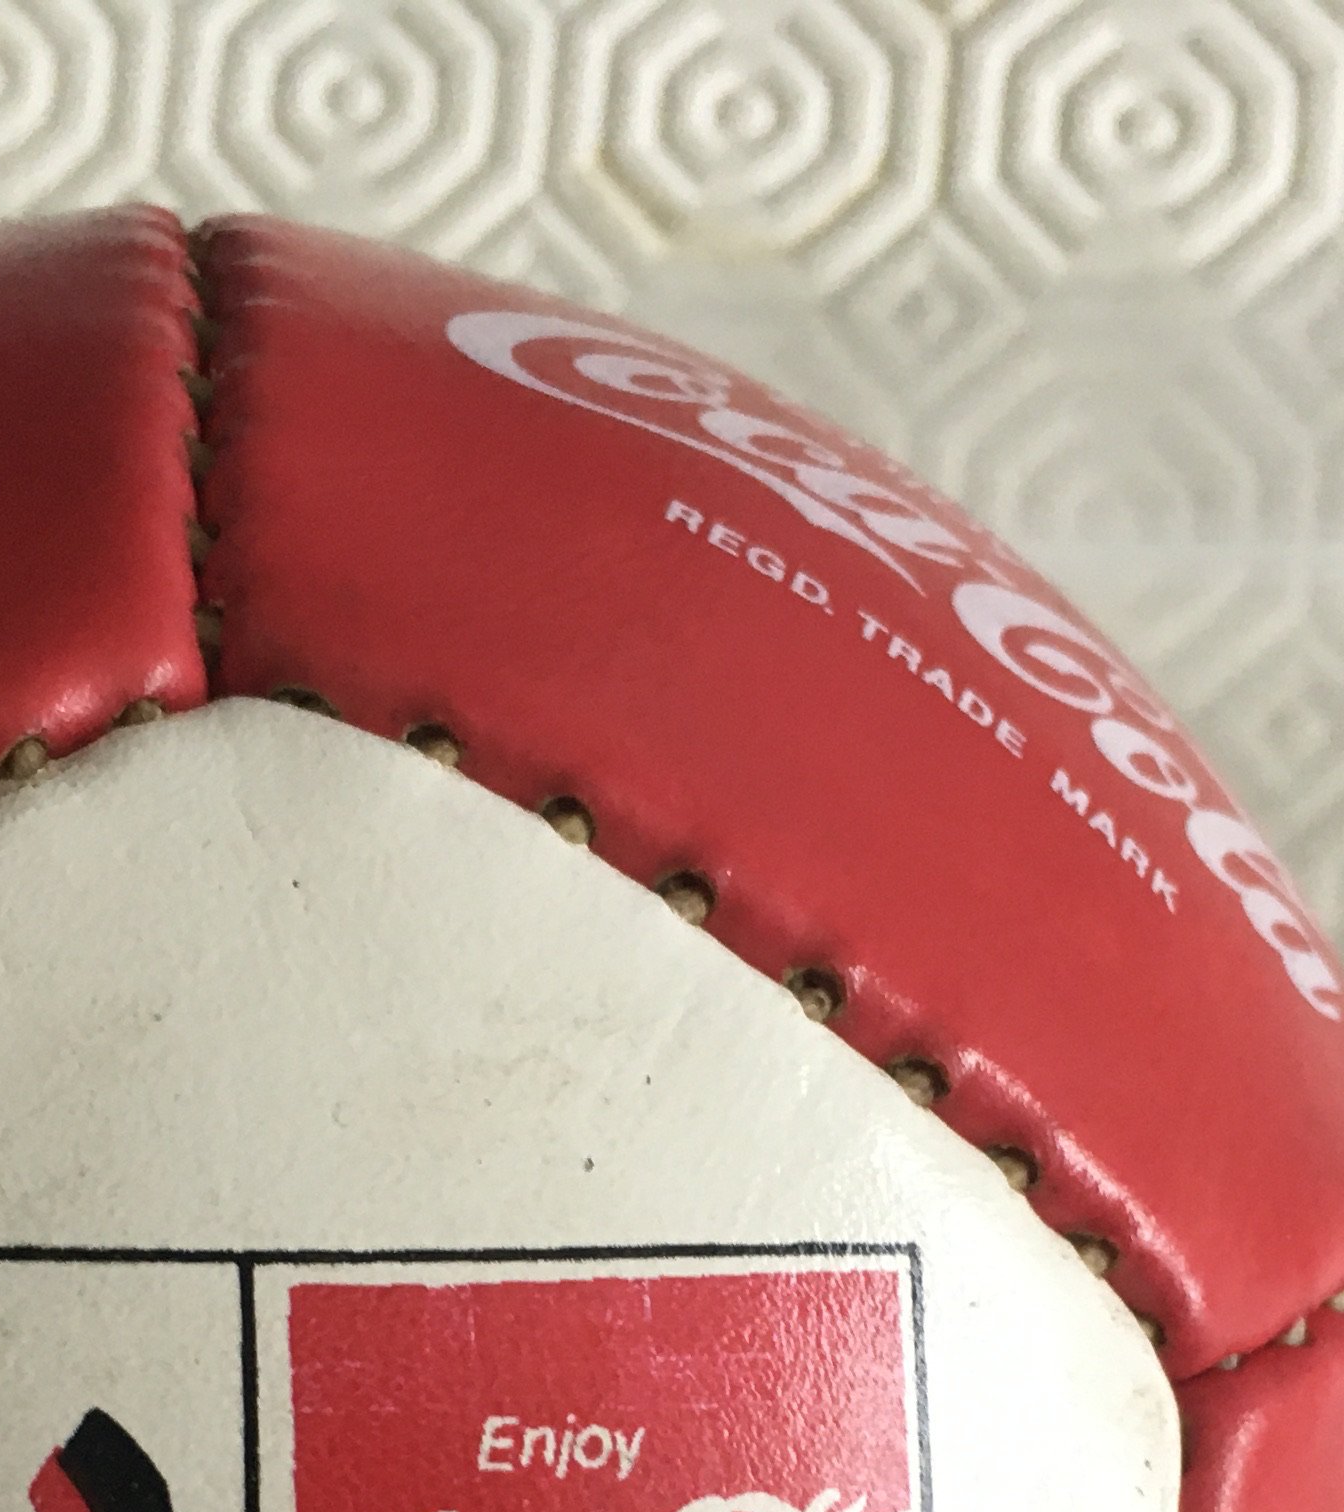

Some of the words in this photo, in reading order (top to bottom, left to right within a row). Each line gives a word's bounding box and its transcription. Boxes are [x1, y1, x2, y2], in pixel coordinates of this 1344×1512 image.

[665, 499, 836, 614] REGD.
[859, 611, 1027, 758] TRADE
[1049, 769, 1180, 914] MARK
[477, 1413, 645, 1480] Enjoy
